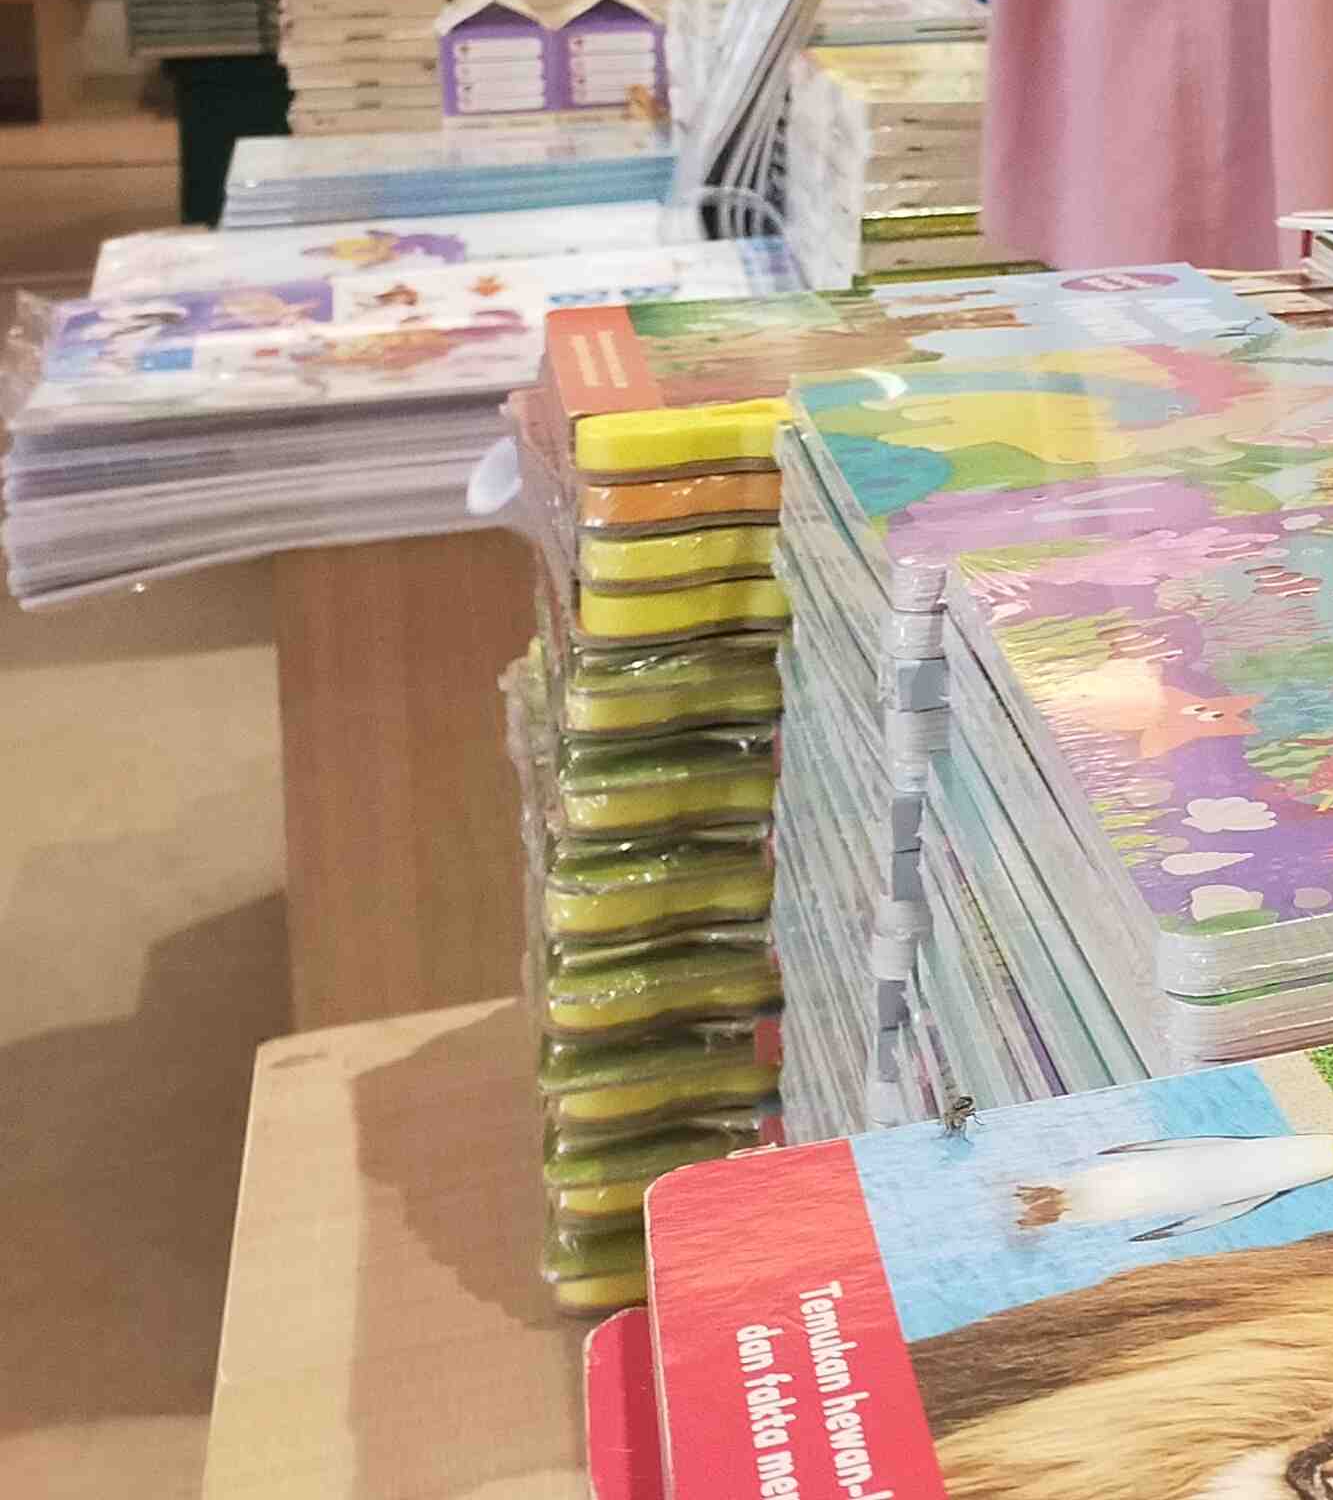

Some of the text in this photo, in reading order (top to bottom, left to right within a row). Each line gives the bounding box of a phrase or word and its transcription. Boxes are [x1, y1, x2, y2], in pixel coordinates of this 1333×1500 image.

[799, 1280, 858, 1393] Temukan
[736, 1323, 800, 1500] dan fakta me
